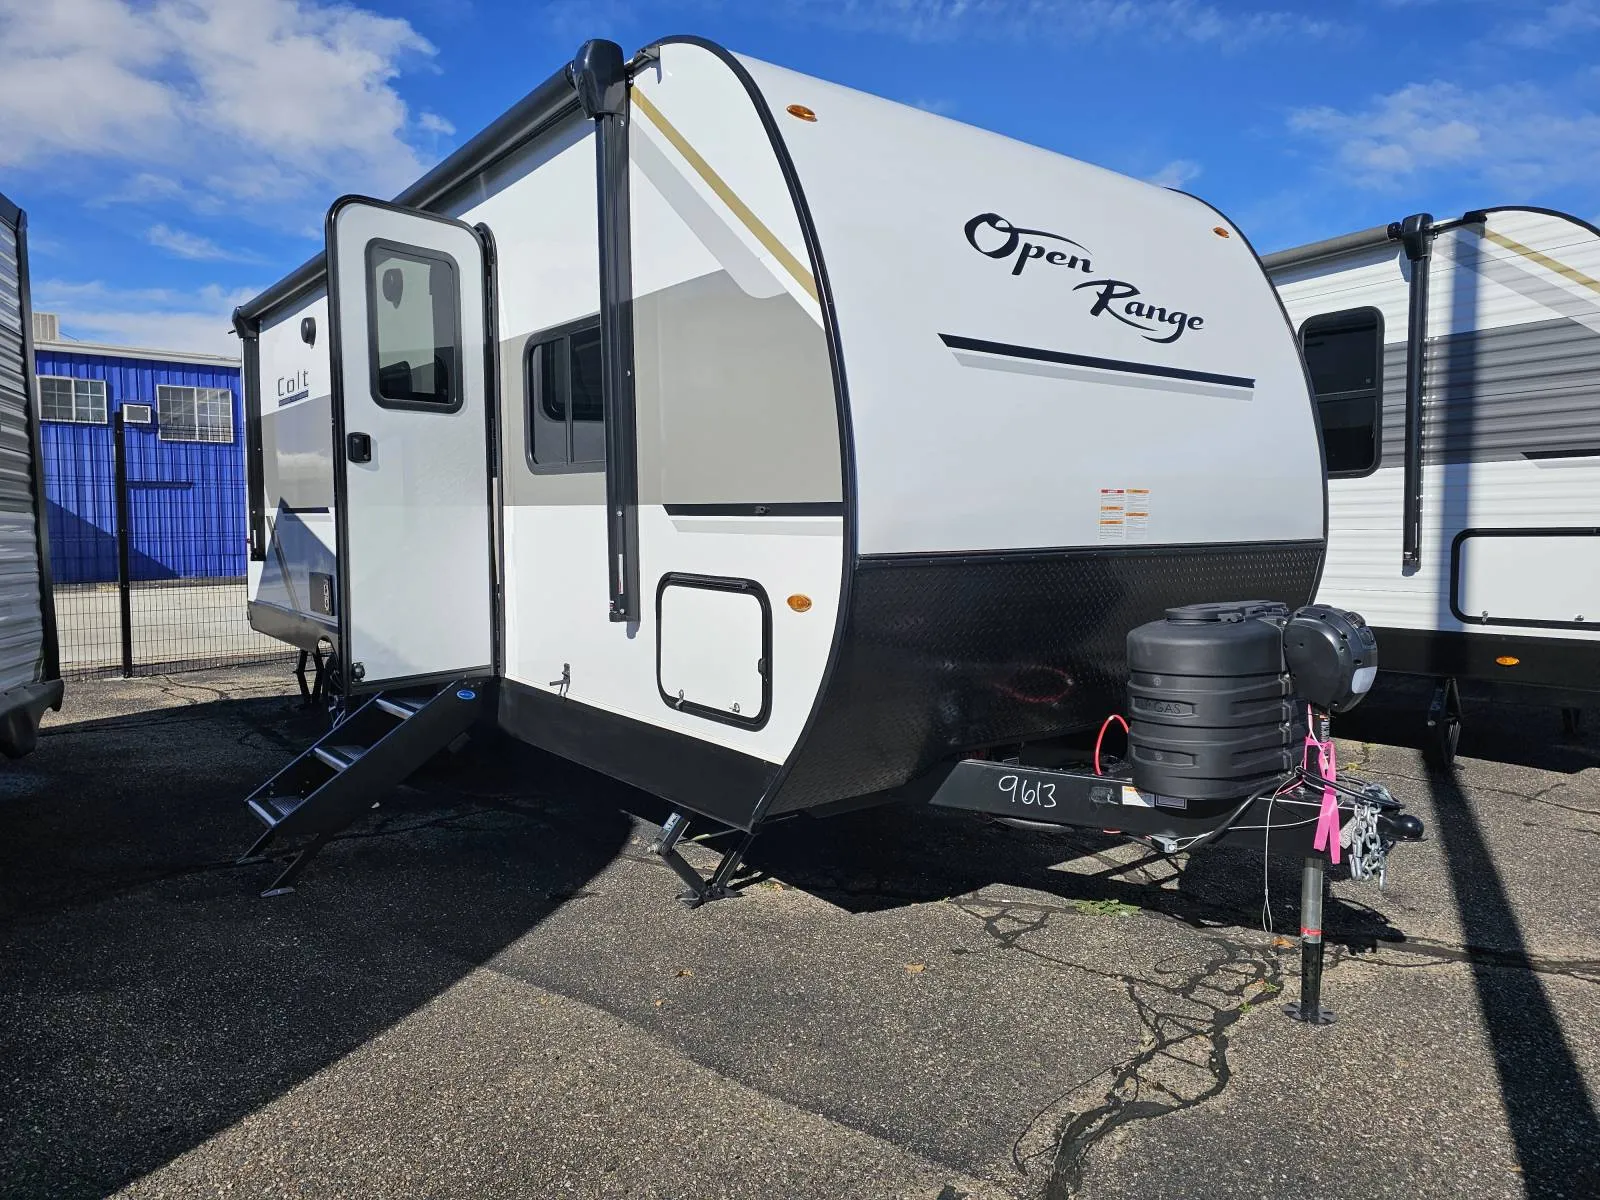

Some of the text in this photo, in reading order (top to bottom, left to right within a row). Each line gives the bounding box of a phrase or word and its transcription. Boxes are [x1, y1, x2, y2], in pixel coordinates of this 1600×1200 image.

[964, 212, 1094, 276] Open
[1072, 278, 1205, 344] Range
[277, 370, 309, 397] Colt
[998, 775, 1057, 808] 9613
